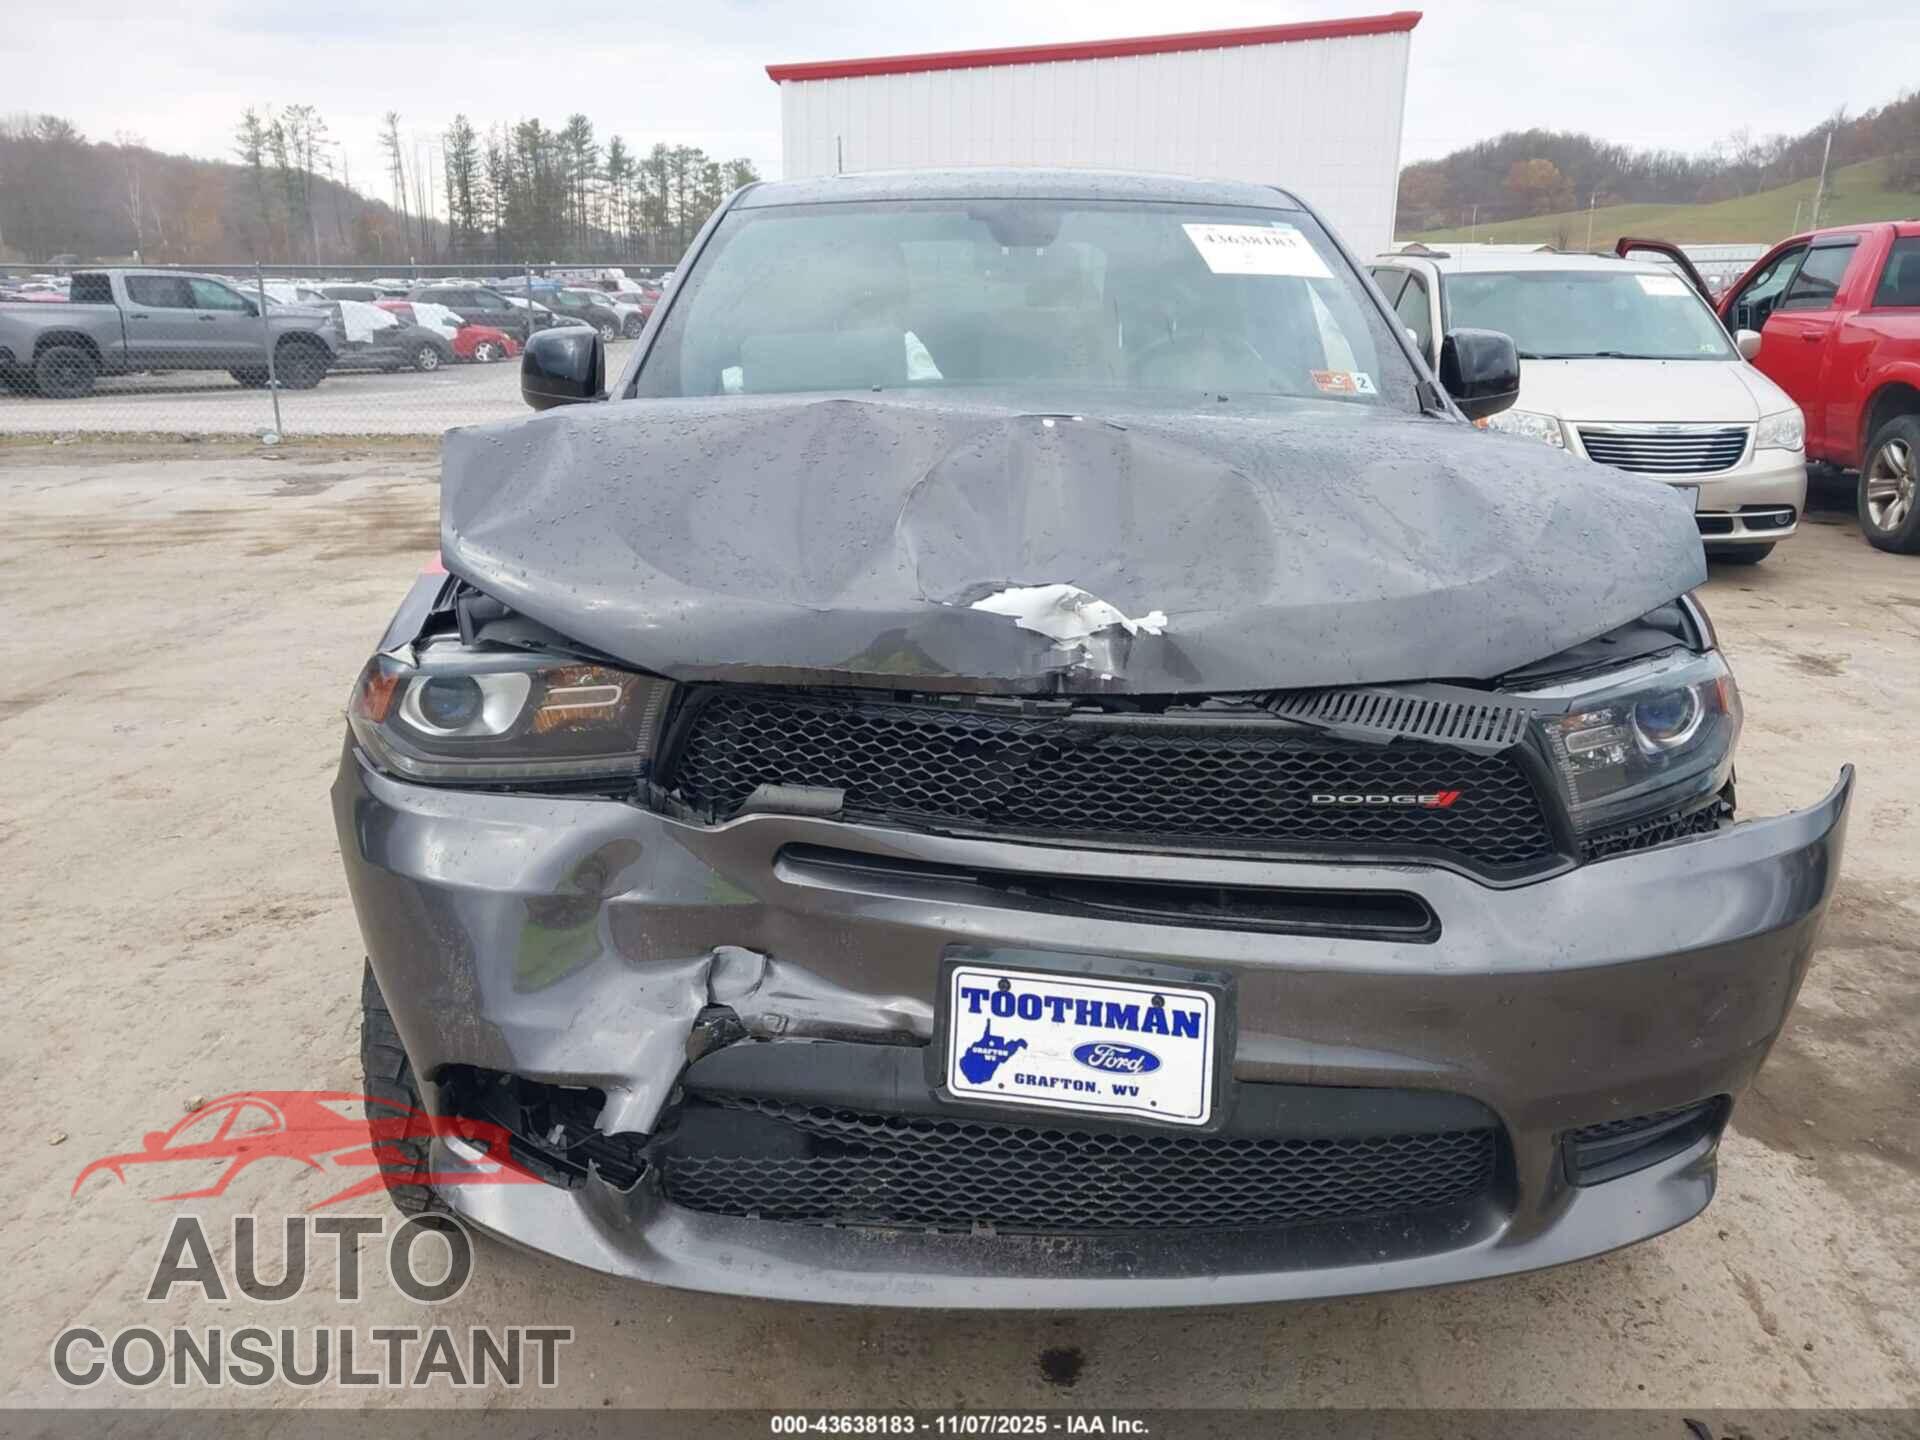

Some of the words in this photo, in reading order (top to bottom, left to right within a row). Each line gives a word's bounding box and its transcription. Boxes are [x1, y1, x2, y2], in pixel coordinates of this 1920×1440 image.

[1312, 794, 1440, 804] DODGE
[961, 987, 1202, 1039] TOOTHMAN
[1087, 1044, 1144, 1073] Ford
[1112, 1084, 1140, 1097] WV
